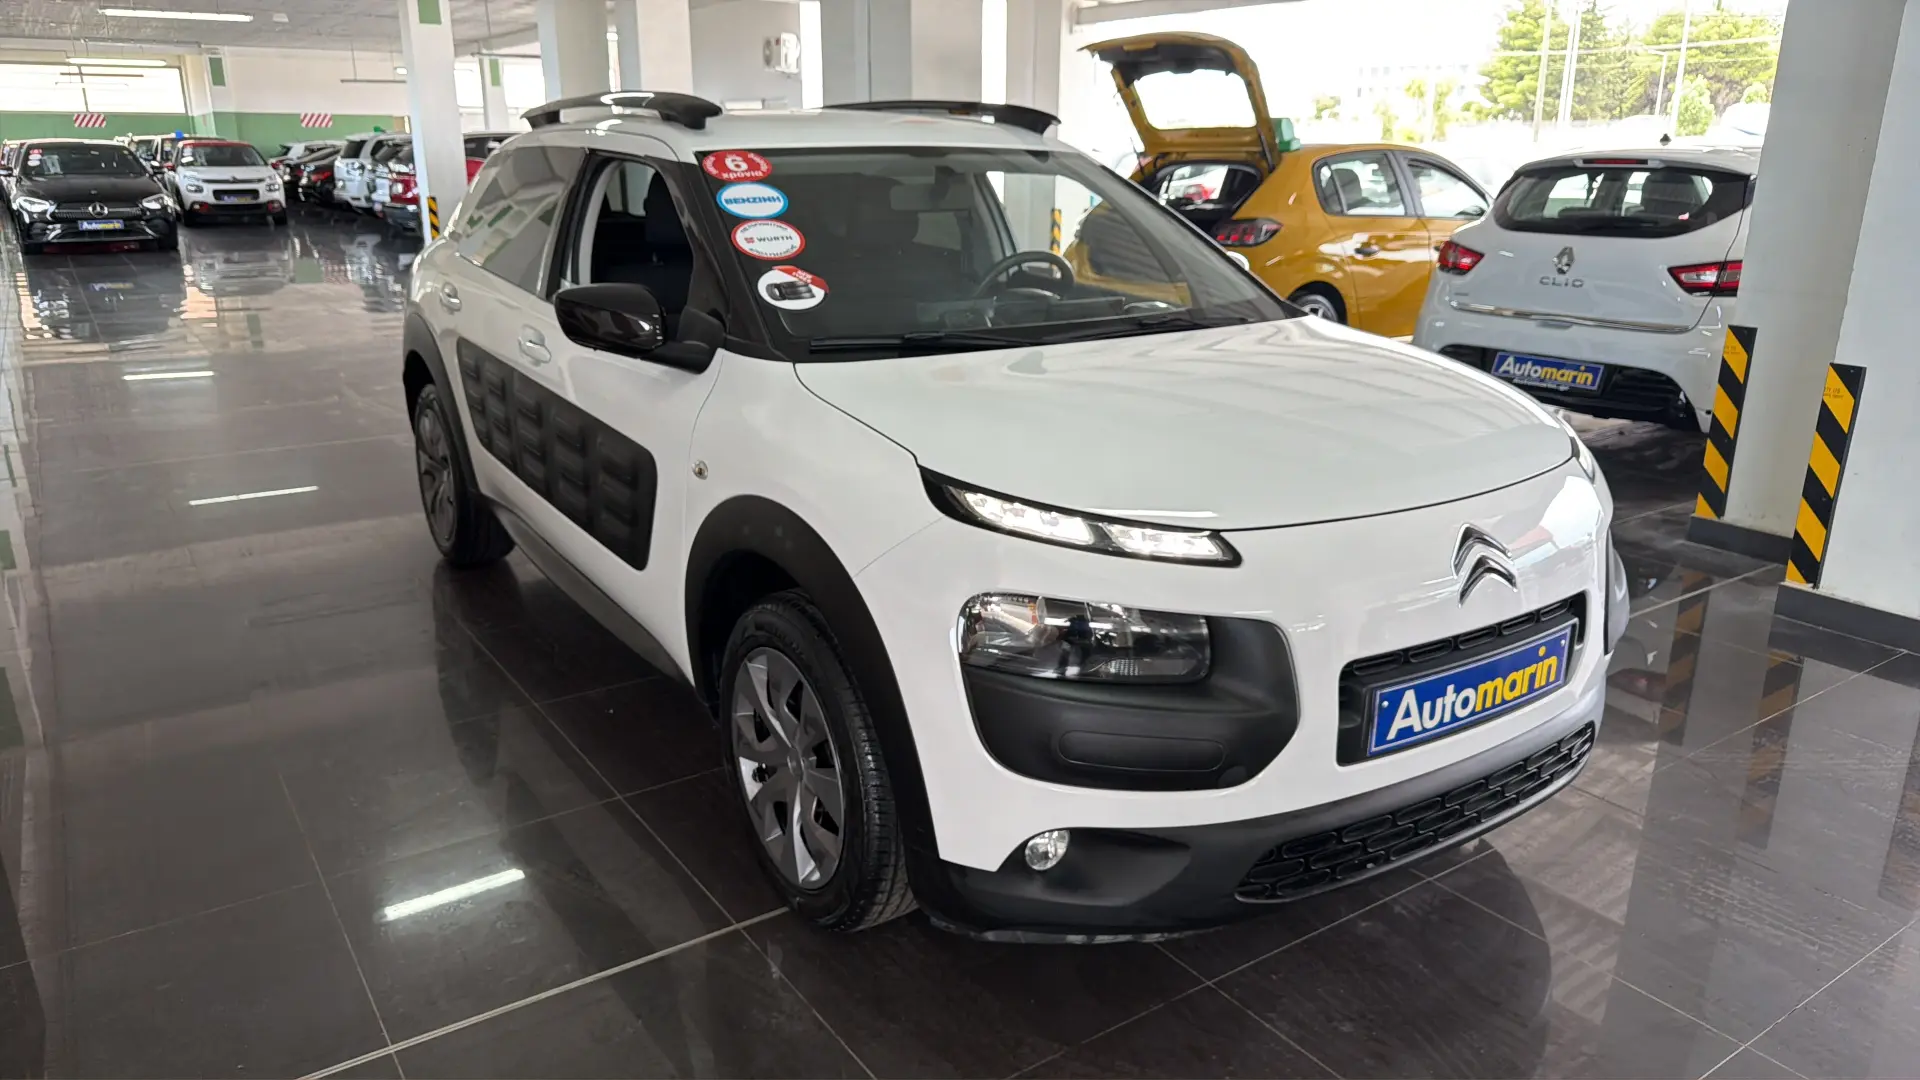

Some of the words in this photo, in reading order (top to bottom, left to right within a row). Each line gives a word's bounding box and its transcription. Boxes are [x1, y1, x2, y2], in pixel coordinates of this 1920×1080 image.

[724, 155, 748, 171] 6
[82, 221, 121, 230] Automarin
[1498, 355, 1593, 385] Automarin
[1386, 646, 1558, 741] Automarin
